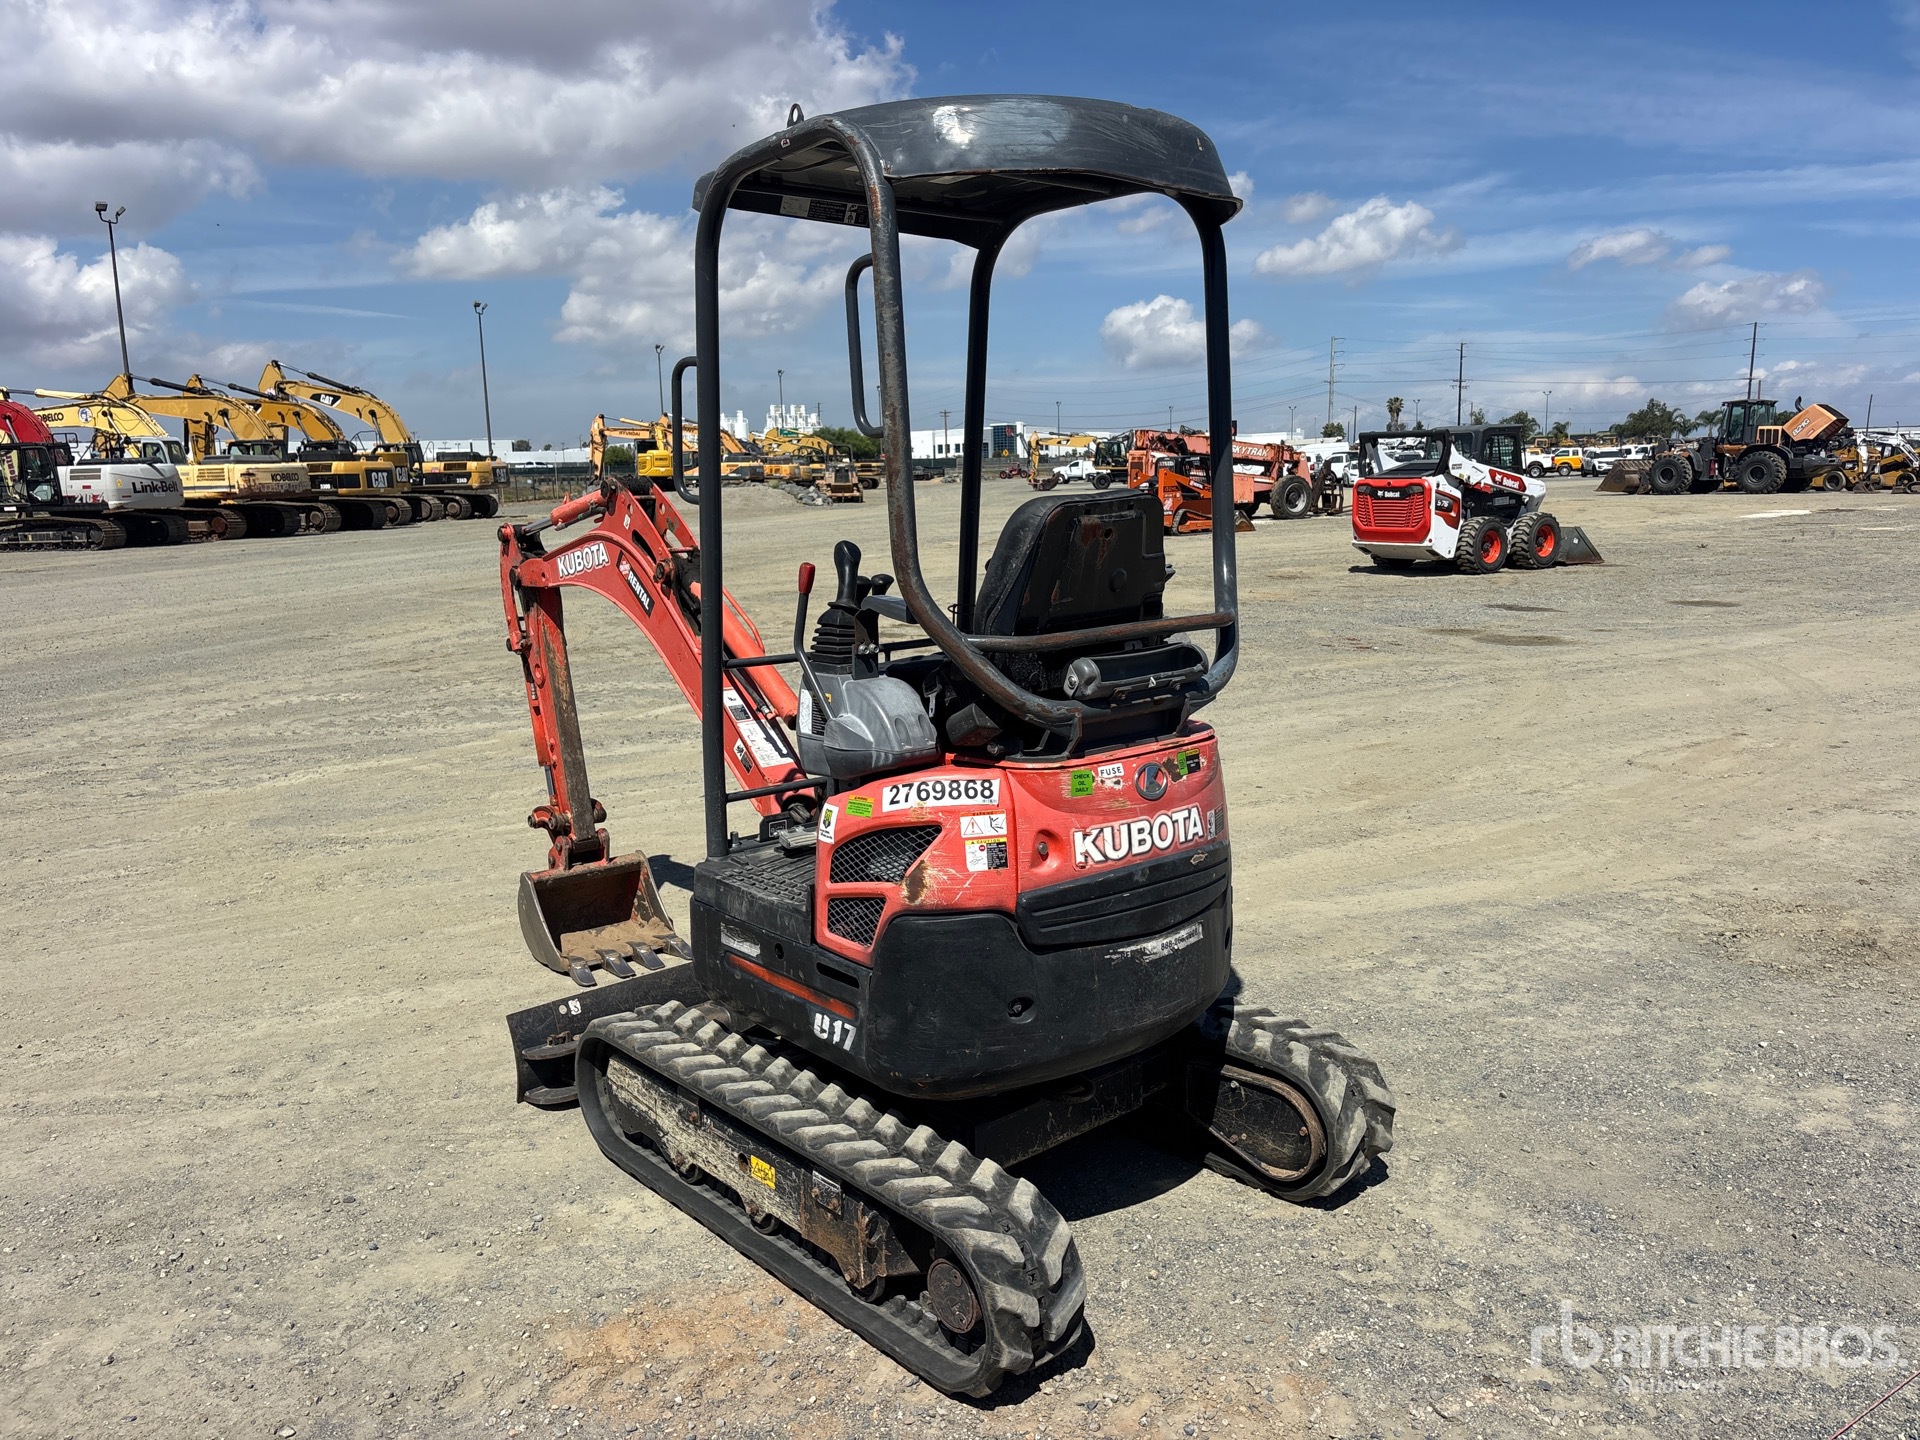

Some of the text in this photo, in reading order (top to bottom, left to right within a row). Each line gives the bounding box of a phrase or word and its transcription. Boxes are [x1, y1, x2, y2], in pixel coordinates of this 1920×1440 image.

[320, 394, 334, 405] CAT
[37, 412, 64, 422] OBELCO
[270, 472, 299, 483] KOBELCO
[371, 471, 388, 488] CAT
[495, 468, 507, 483] CAT
[131, 480, 179, 494] Link-Belt
[1502, 476, 1520, 490] Bobcat
[1384, 490, 1400, 498] Bobcat
[557, 542, 609, 578] KUBOTA
[627, 570, 651, 611] RENTAL
[1100, 766, 1122, 777] FUSE
[888, 779, 995, 806] 2769868
[1073, 805, 1204, 866] KUBOTA
[813, 1012, 857, 1052] U17
